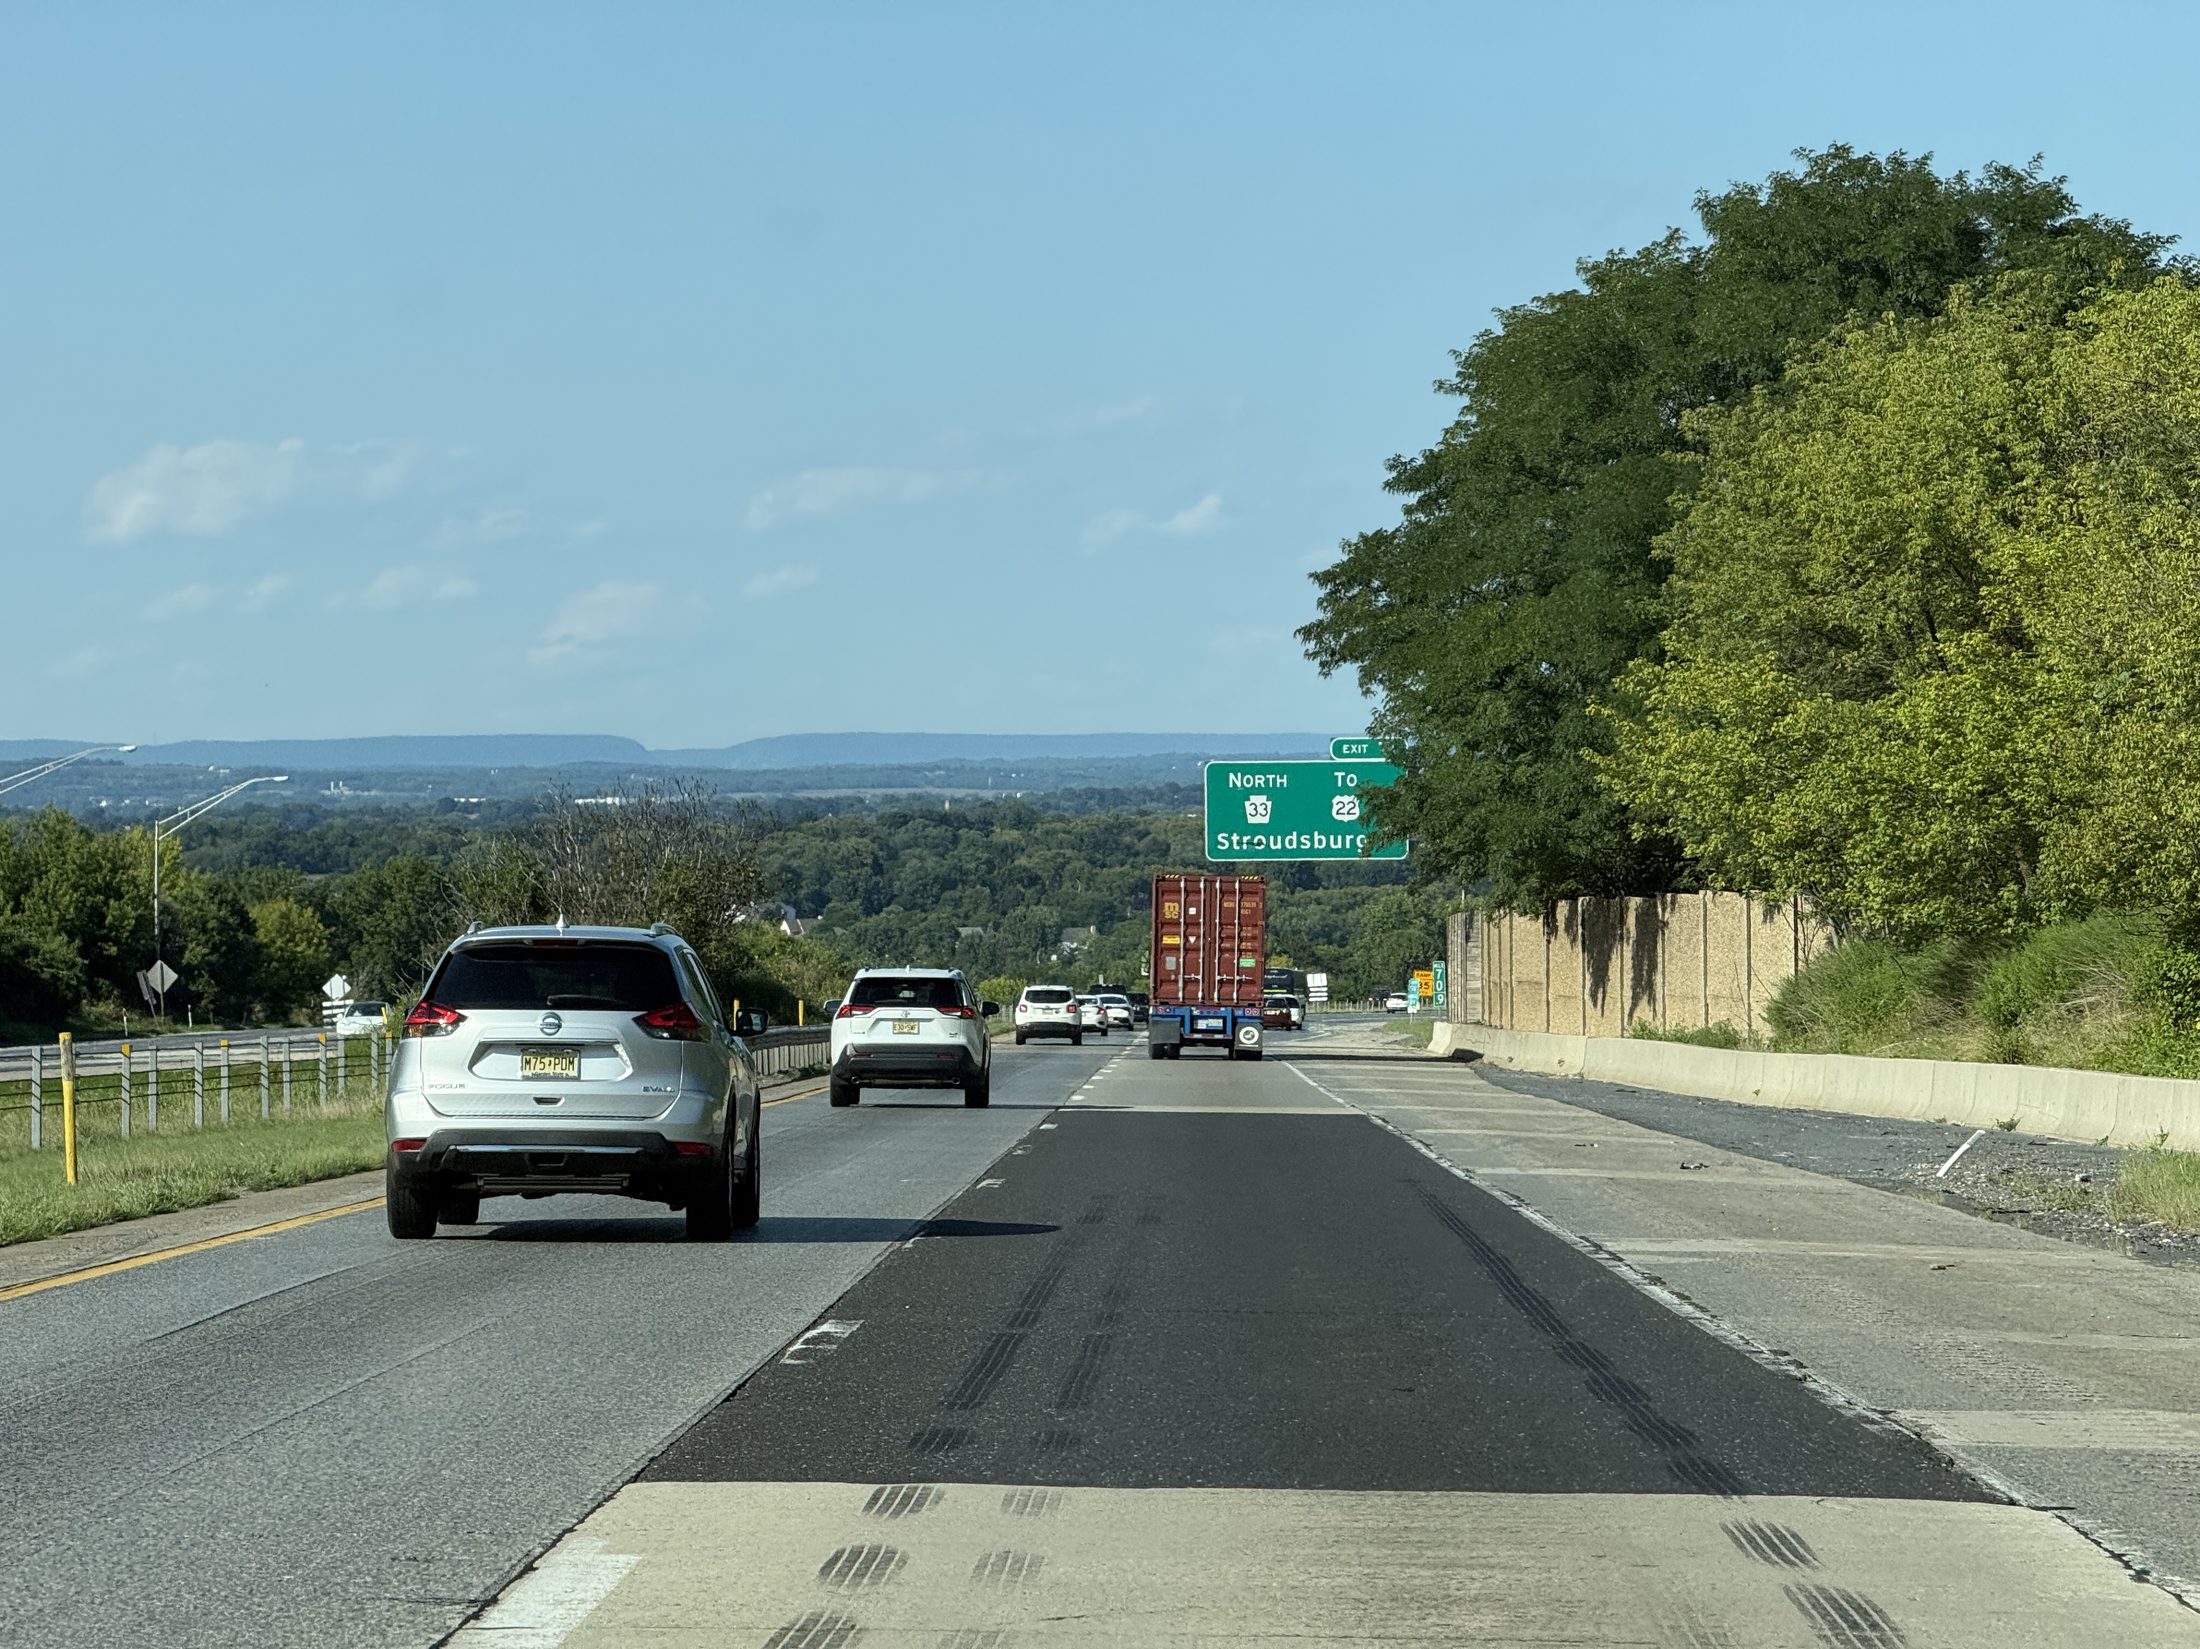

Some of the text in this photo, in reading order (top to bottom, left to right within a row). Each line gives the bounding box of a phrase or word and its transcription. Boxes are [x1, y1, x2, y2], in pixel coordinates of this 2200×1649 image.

[1342, 744, 1369, 754] EXIT
[1228, 772, 1288, 788] NORTH
[1248, 802, 1269, 817] 33
[1335, 800, 1357, 816] 22
